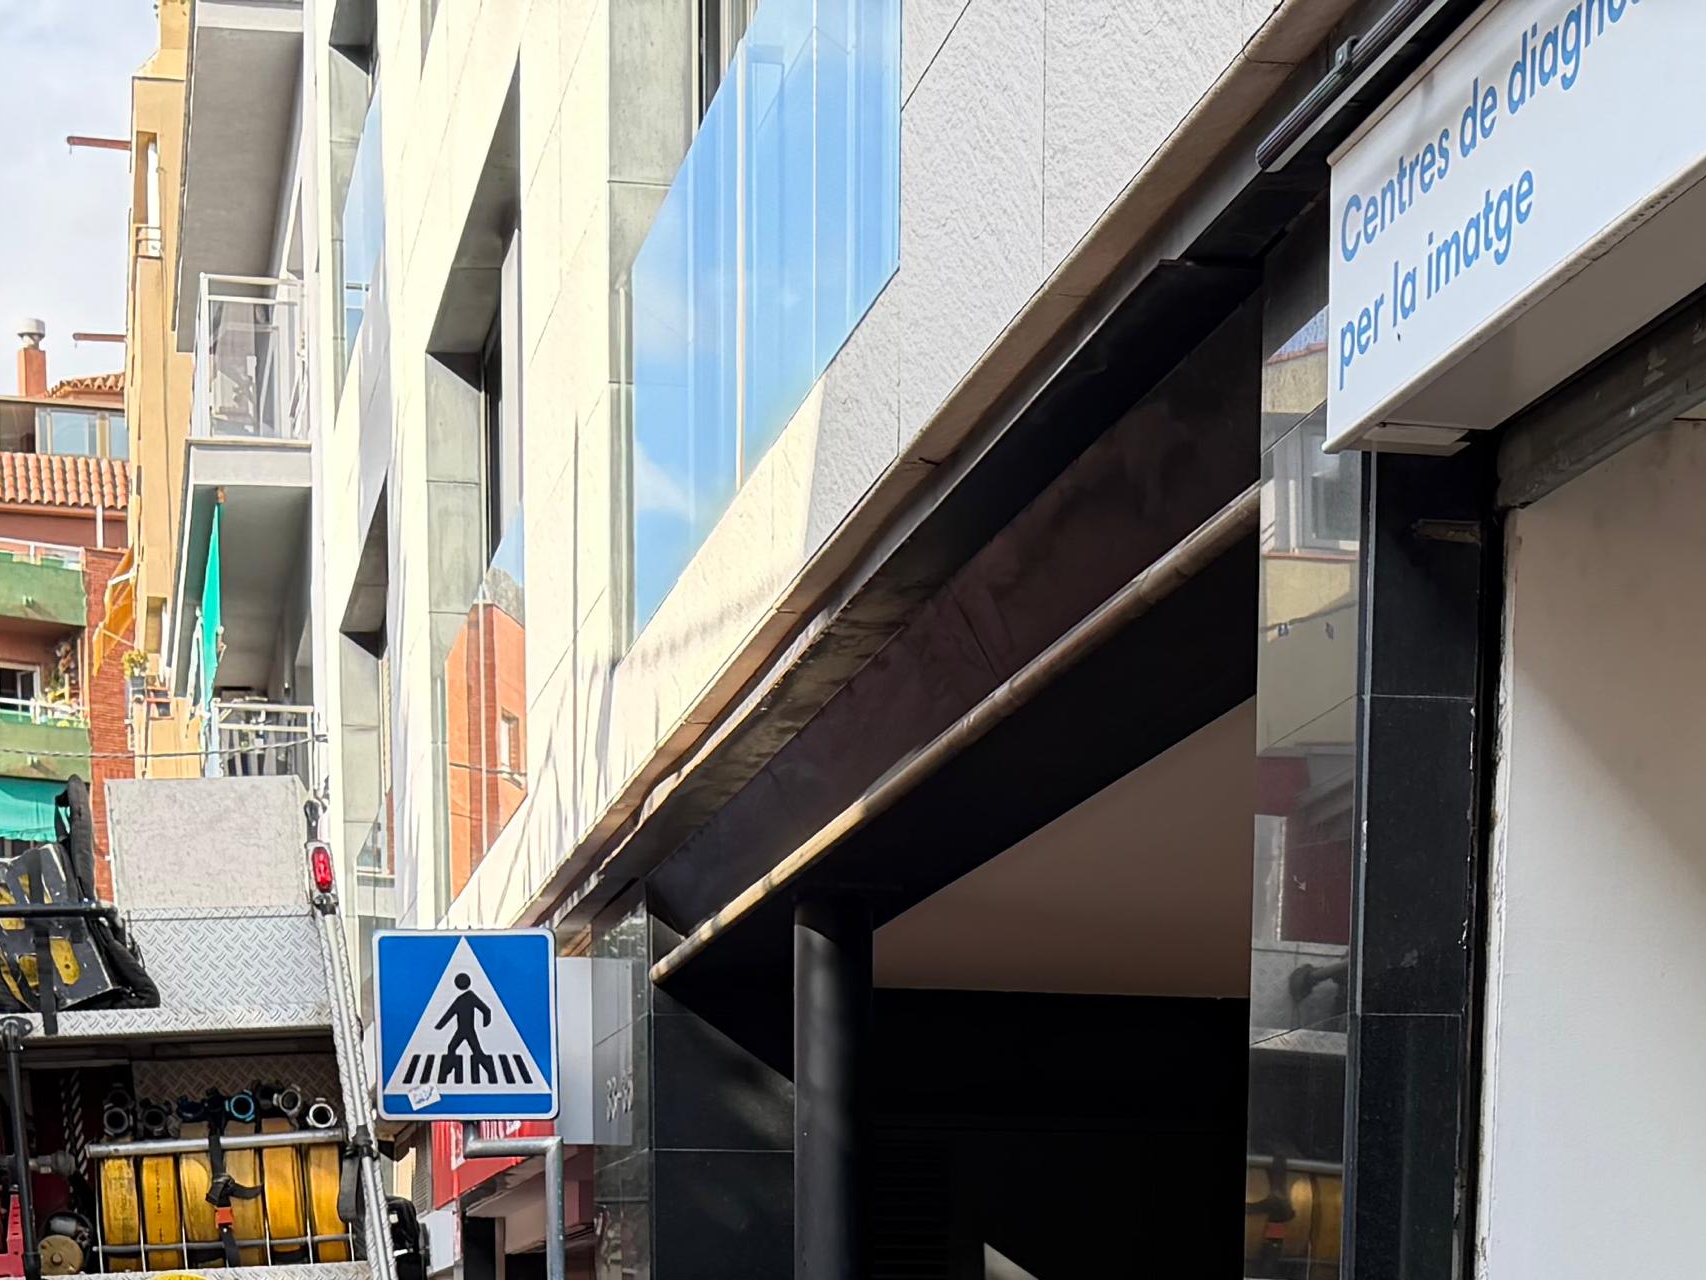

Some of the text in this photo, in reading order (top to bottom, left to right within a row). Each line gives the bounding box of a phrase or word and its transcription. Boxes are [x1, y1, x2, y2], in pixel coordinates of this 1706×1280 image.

[1340, 127, 1450, 263] Centres
[1459, 77, 1497, 158] de
[1338, 169, 1534, 391] per la imatge
